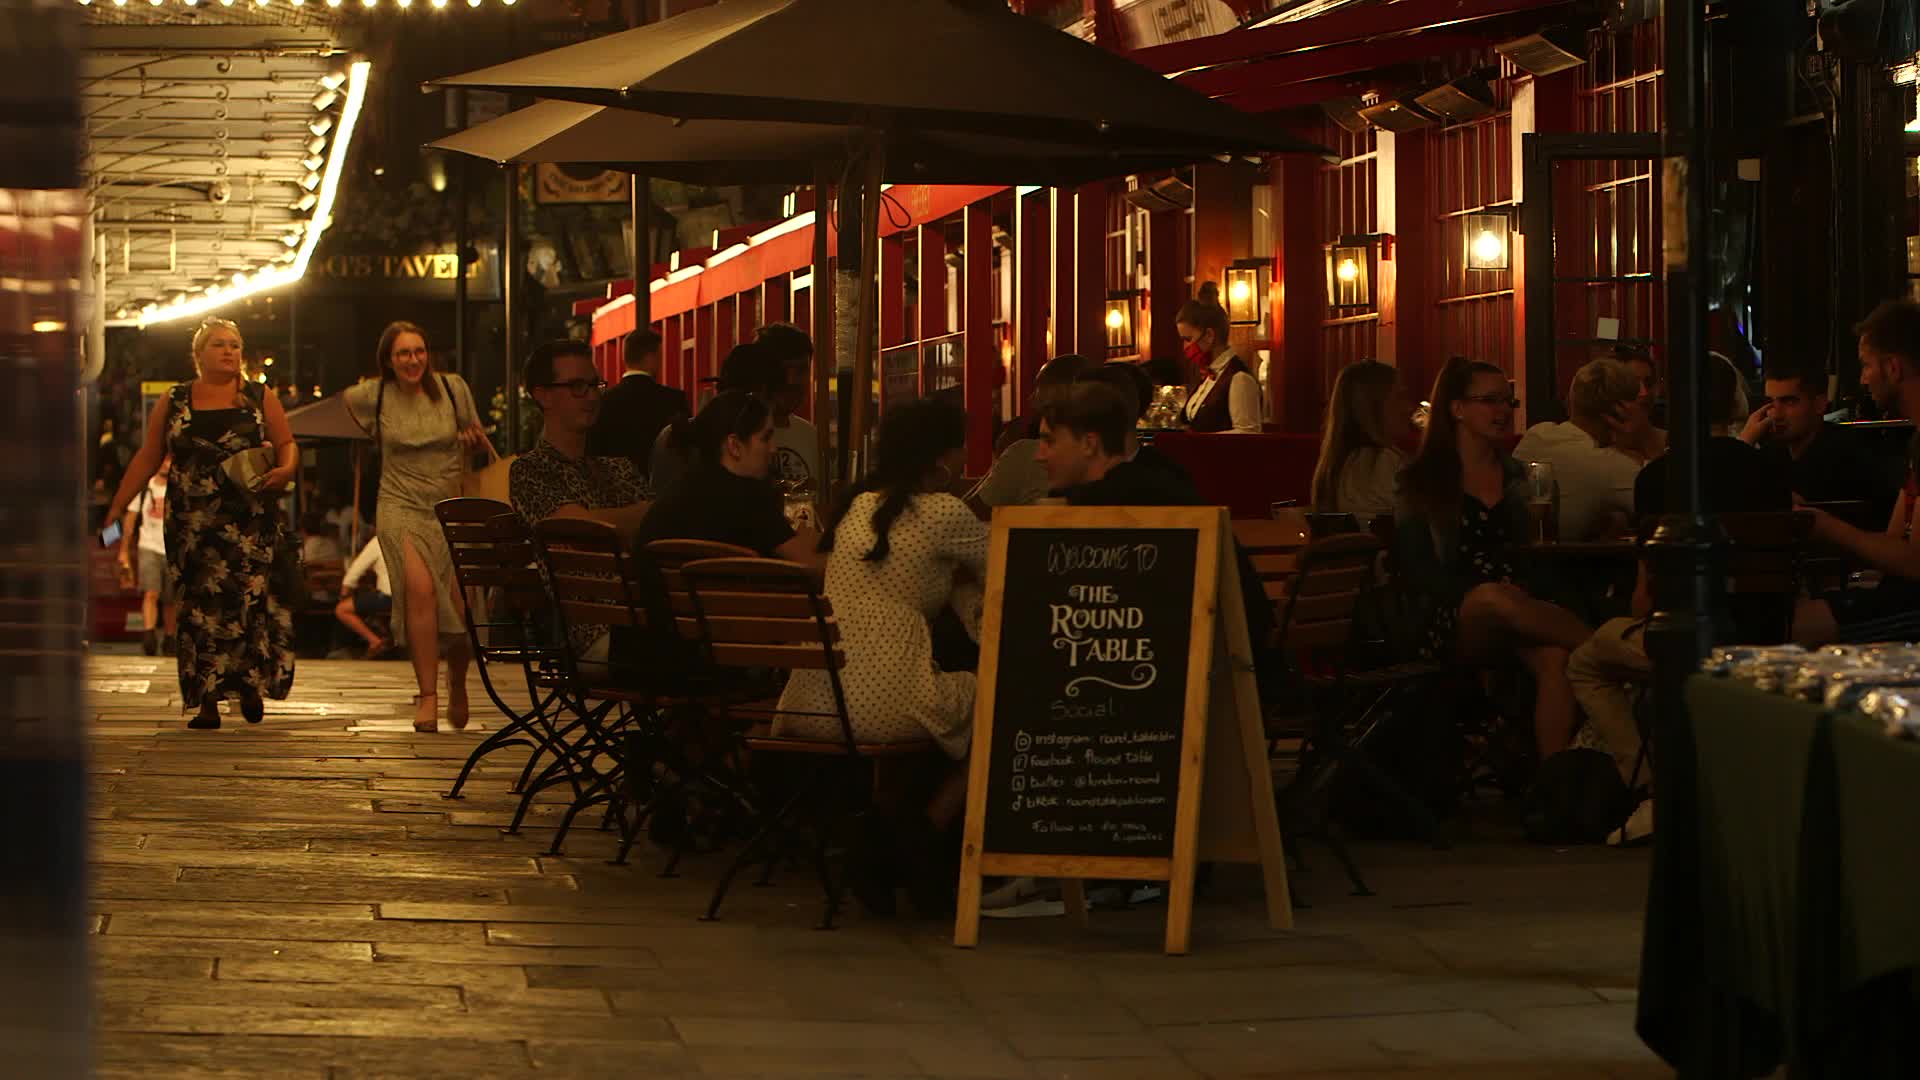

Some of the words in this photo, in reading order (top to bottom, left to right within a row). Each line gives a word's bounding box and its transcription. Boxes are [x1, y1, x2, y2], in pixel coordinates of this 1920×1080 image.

[1047, 542, 1128, 575] WELCOME
[1133, 543, 1158, 574] TO
[1068, 584, 1118, 603] THE
[1049, 604, 1143, 639] ROUND
[1053, 637, 1154, 667] TABLE
[1050, 696, 1116, 720] Social
